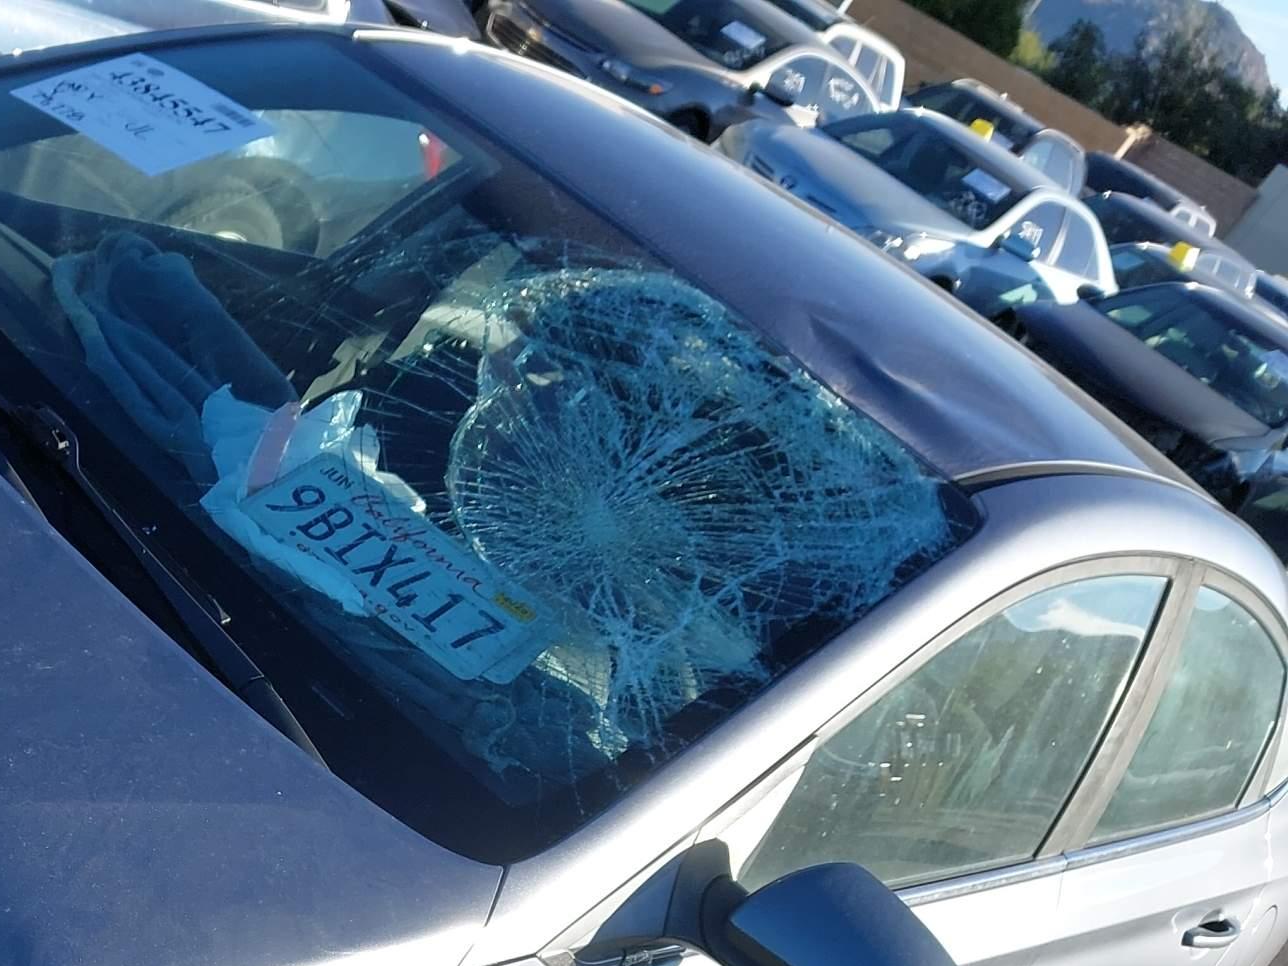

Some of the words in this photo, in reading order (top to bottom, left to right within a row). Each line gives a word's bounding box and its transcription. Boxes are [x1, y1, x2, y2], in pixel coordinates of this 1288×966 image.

[110, 71, 231, 134] 43845547
[319, 466, 355, 489] JUN
[265, 484, 507, 650] 9BIX417
[350, 493, 491, 602] California
